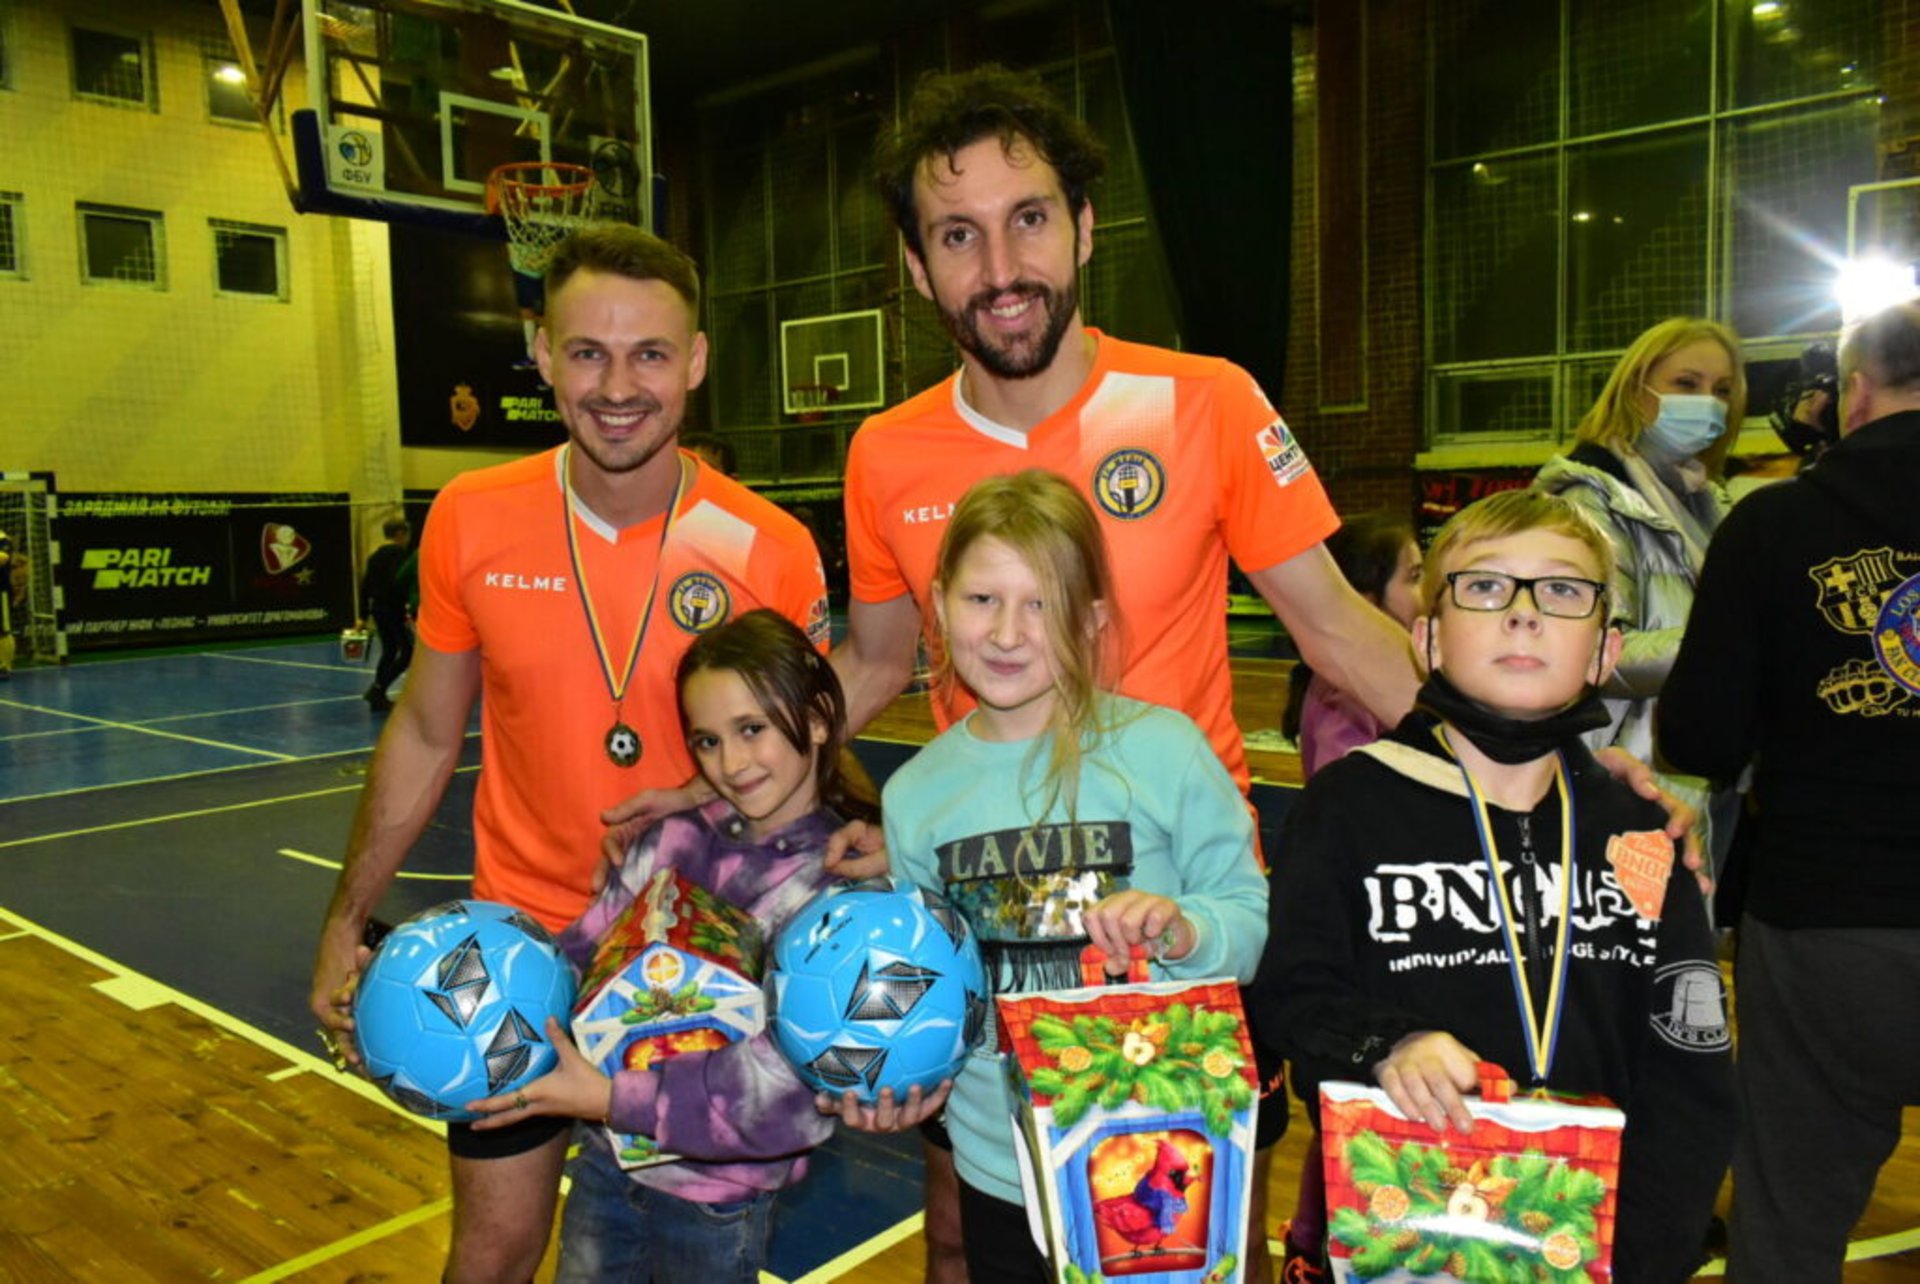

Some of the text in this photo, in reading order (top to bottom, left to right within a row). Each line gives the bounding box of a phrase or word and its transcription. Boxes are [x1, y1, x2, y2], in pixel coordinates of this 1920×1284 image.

[94, 548, 171, 568] PARI
[106, 566, 211, 589] MATCH
[485, 572, 567, 591] KELME
[1020, 824, 1112, 871] VIE
